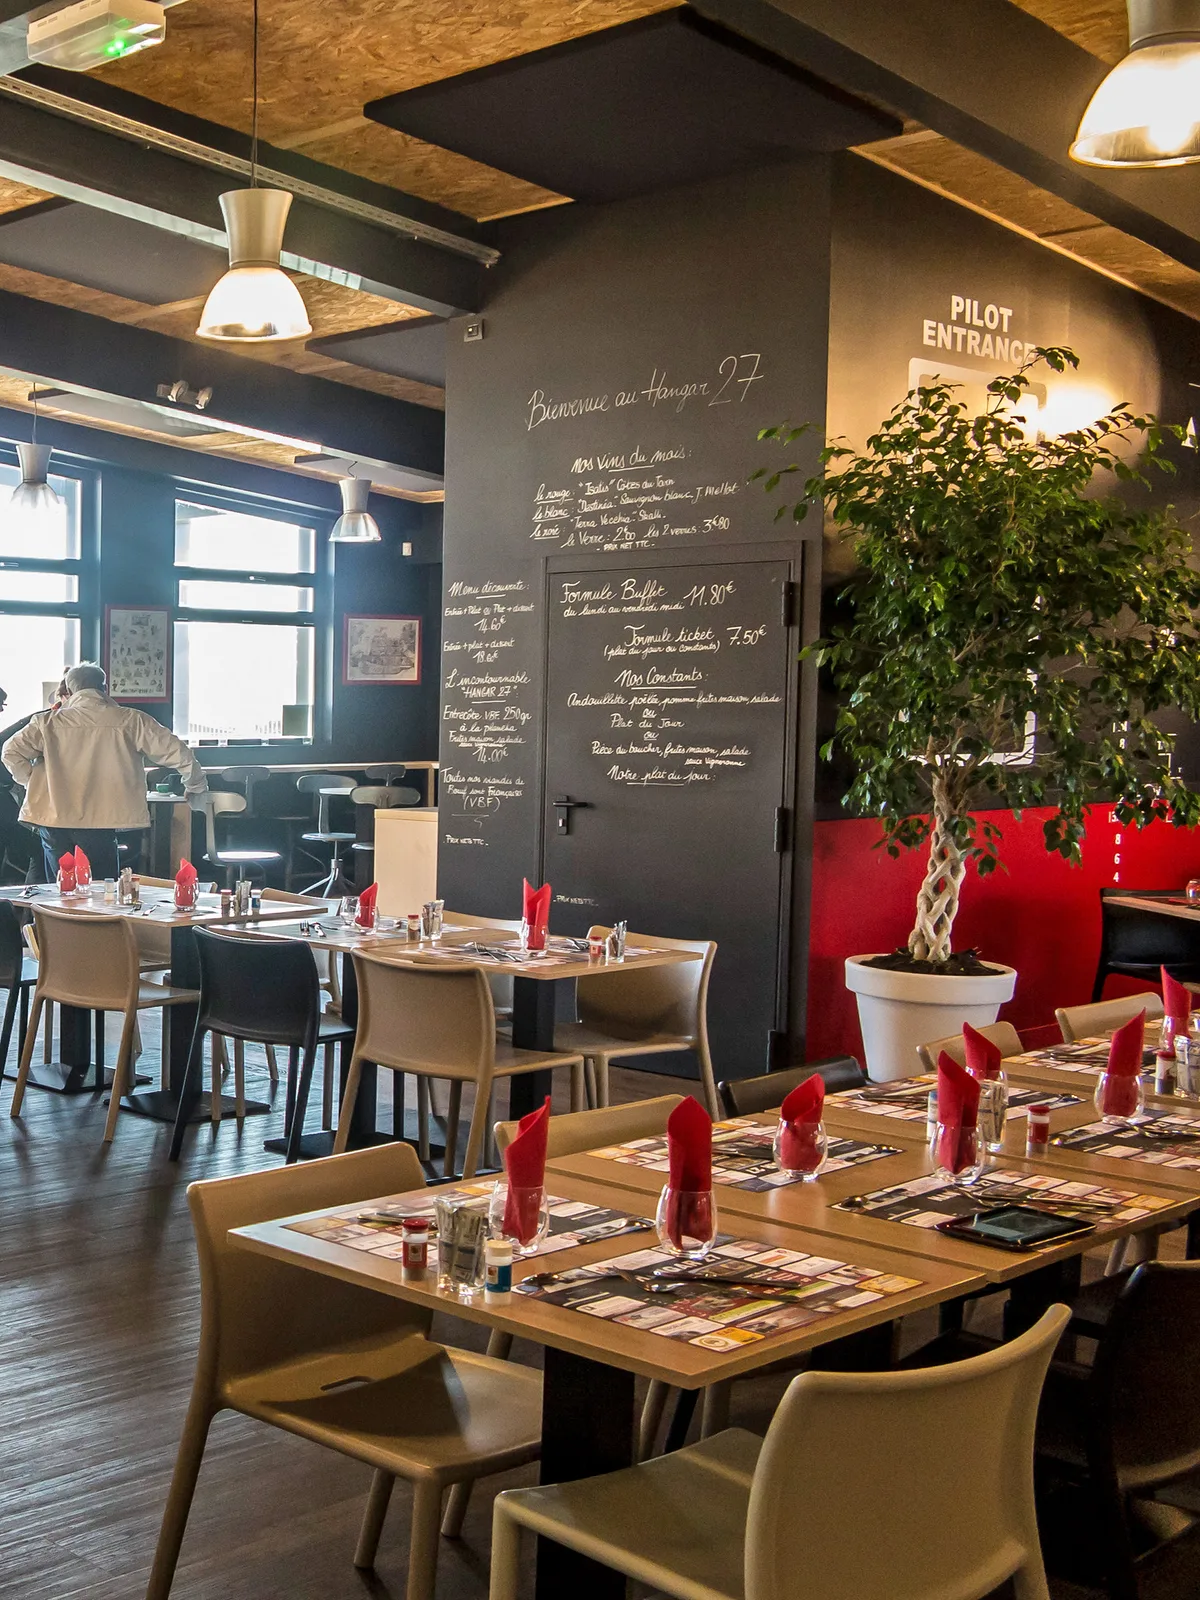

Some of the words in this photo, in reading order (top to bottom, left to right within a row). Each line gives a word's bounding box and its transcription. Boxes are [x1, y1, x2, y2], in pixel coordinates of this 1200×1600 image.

[950, 294, 1013, 333] PILOT
[922, 319, 1037, 366] ENTRANCE
[525, 389, 610, 431] Bienvenue
[615, 390, 638, 408] au
[641, 368, 710, 413] Hangar
[708, 353, 764, 407] 27
[629, 445, 647, 465] du
[661, 524, 670, 536] 2
[447, 581, 481, 597] Menu
[559, 580, 618, 604] Formule
[620, 578, 668, 606] Buffet
[563, 606, 578, 618] du
[578, 603, 607, 616] lundi
[659, 601, 685, 611] midi
[623, 624, 675, 647] Formule
[675, 627, 715, 643] ticket
[628, 645, 641, 655] du
[641, 645, 667, 660] jour
[666, 645, 677, 653] ou
[614, 669, 644, 688] Nos
[567, 692, 629, 708] Andouillette
[442, 704, 482, 720] Entrecôte
[642, 707, 657, 718] ou
[468, 721, 483, 732] la
[610, 712, 634, 728] Plat
[638, 719, 653, 728] du
[657, 717, 685, 729] Jour
[643, 730, 659, 741] ou
[615, 744, 629, 755] du
[719, 745, 752, 757] salade
[514, 776, 526, 786] de
[607, 764, 640, 781] Notre
[640, 765, 668, 788] plat
[667, 769, 683, 781] du
[1114, 833, 1122, 845] 8
[1113, 853, 1122, 865] 6
[1112, 872, 1121, 883] 4
